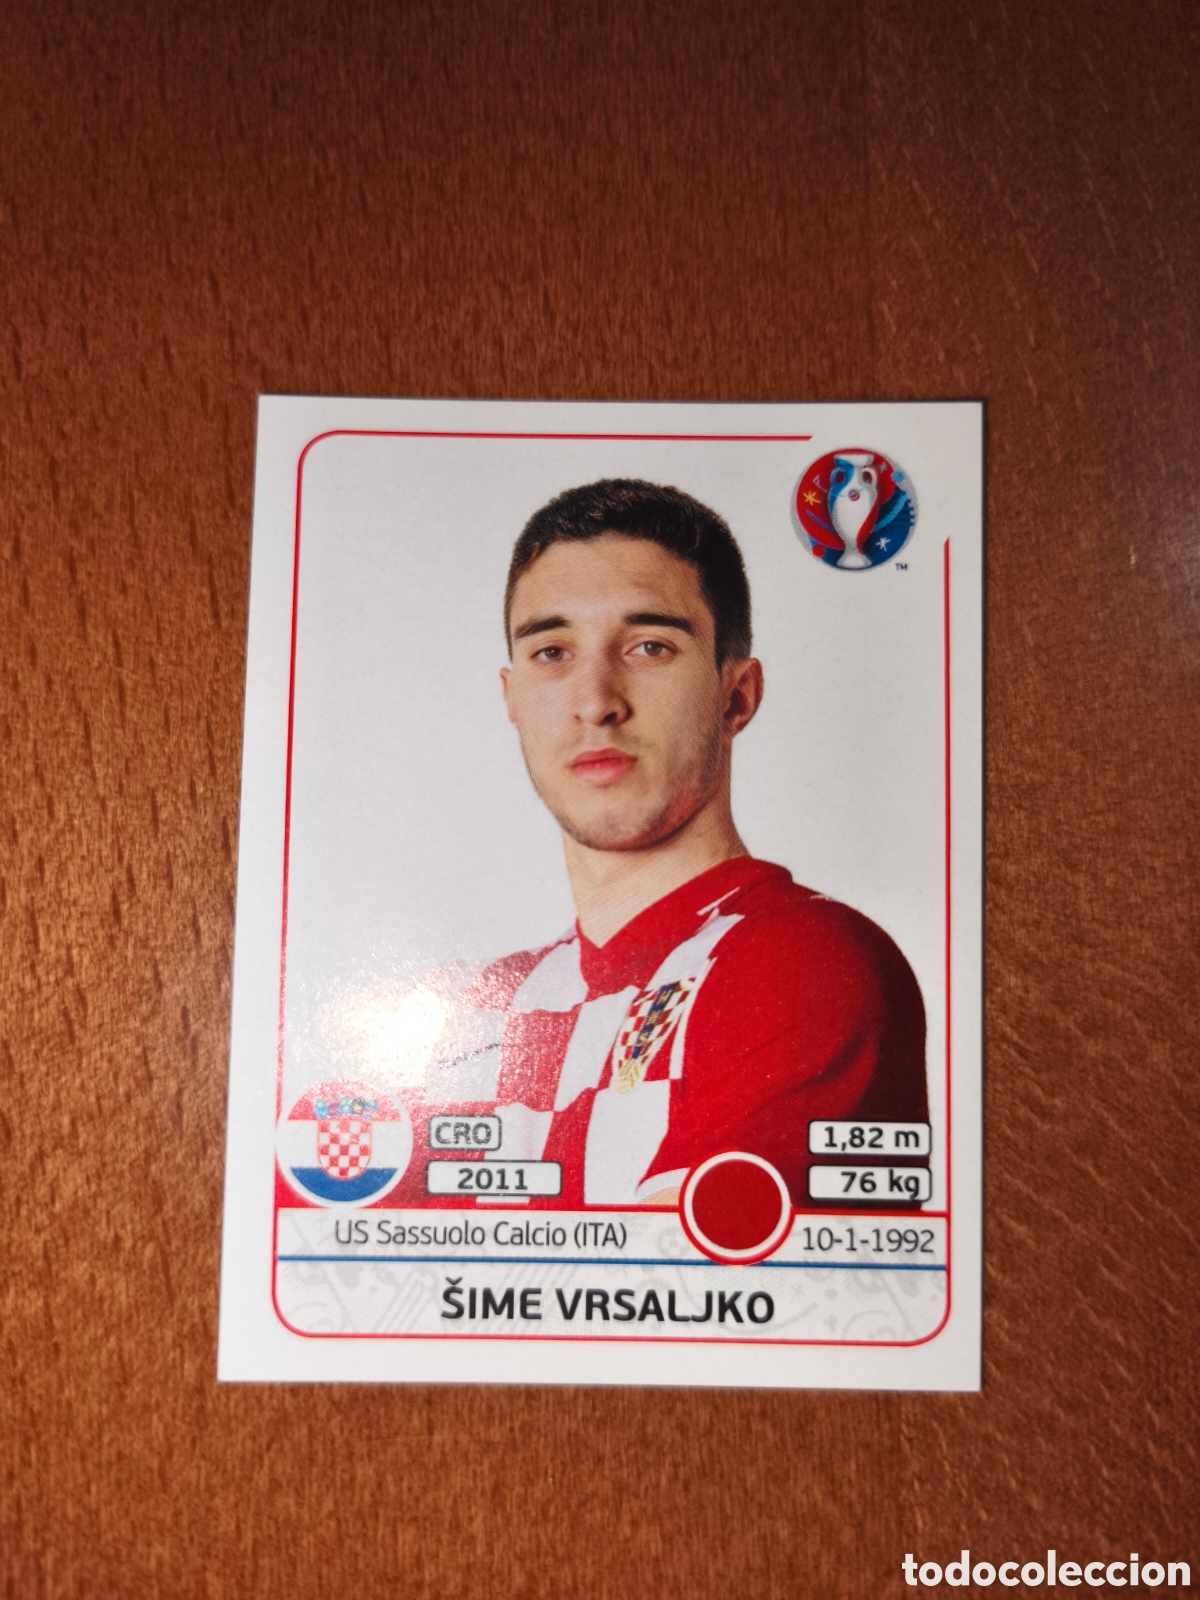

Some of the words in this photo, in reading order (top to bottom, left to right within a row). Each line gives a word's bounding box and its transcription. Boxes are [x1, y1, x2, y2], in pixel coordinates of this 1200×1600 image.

[434, 1122, 493, 1145] CRO
[824, 1125, 884, 1152] 1,82
[894, 1129, 920, 1149] m
[457, 1167, 528, 1190] 2011
[840, 1171, 877, 1193] 76
[888, 1169, 920, 1204] kg
[335, 1219, 369, 1244] US
[376, 1220, 485, 1246] Sassuolo
[493, 1221, 566, 1247] Calcio
[573, 1221, 627, 1249] (ITA)
[802, 1226, 935, 1253] 10-1-1992
[441, 1276, 543, 1320] ŠIME
[555, 1287, 775, 1324] VRSALJKO
